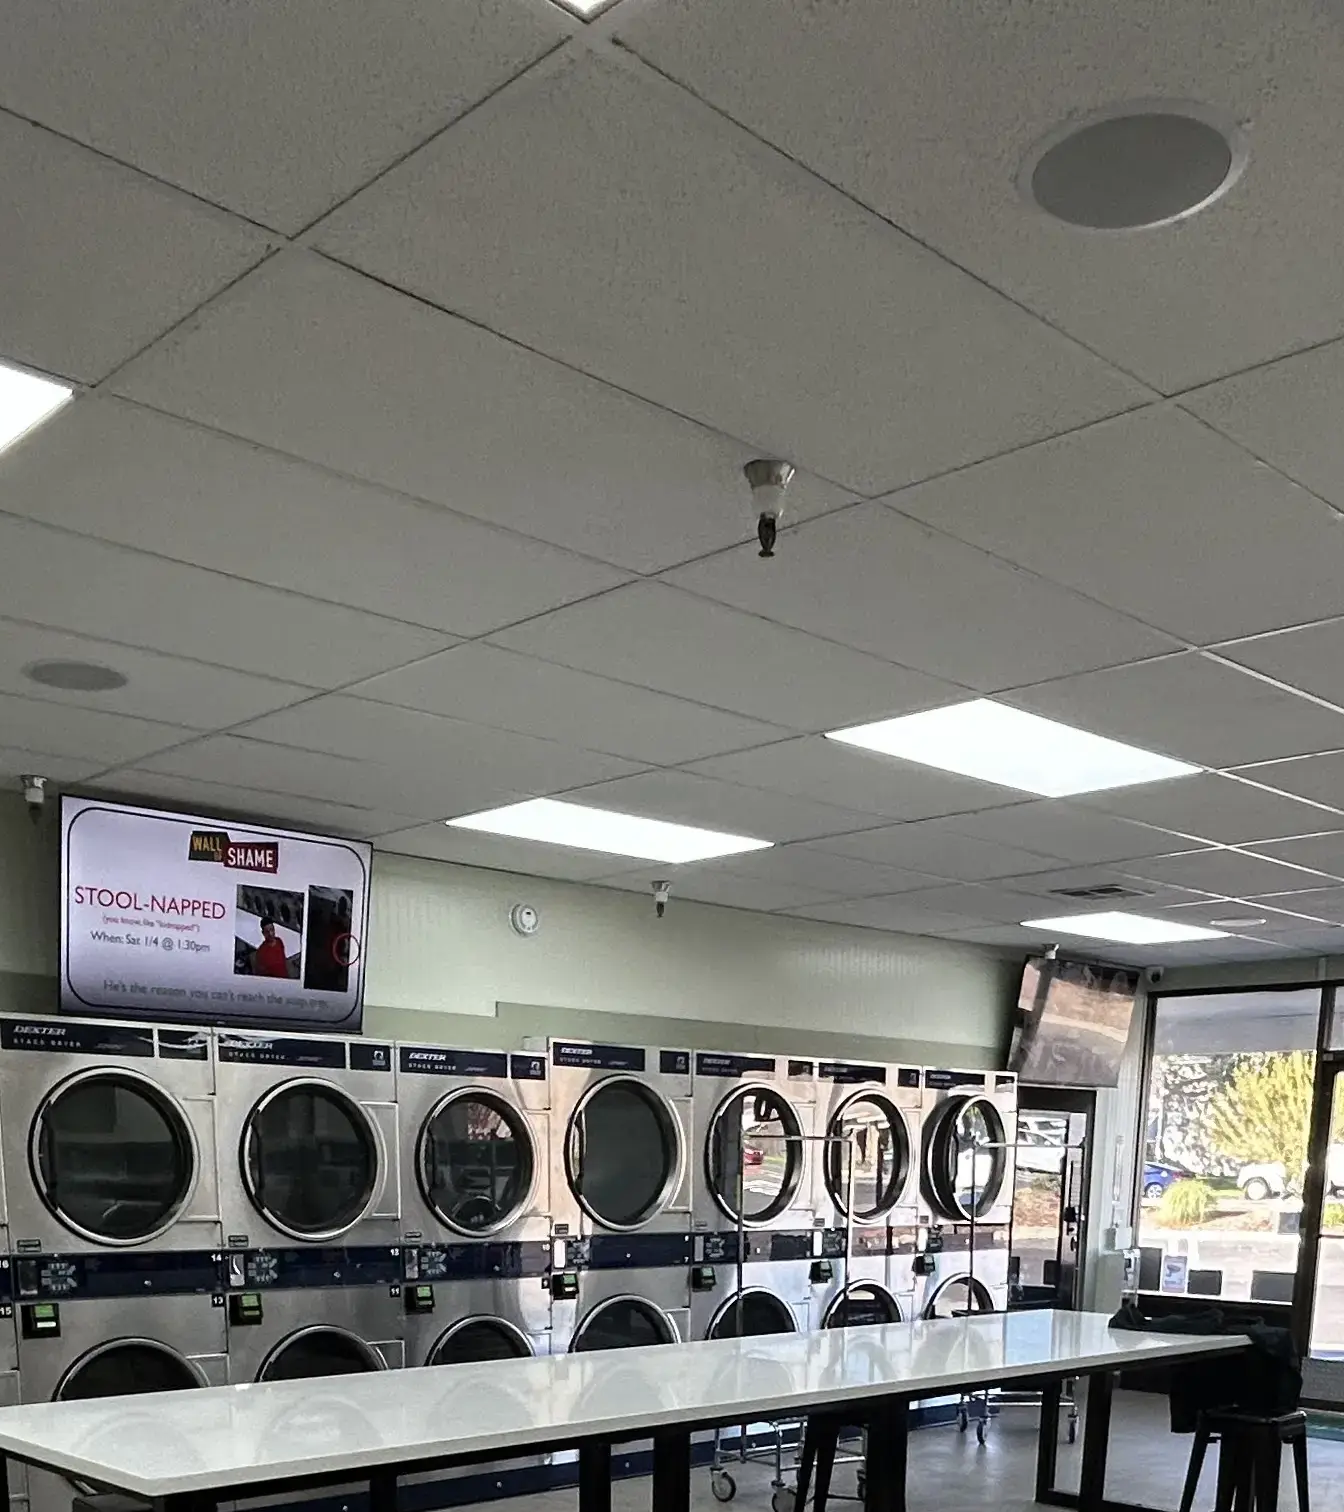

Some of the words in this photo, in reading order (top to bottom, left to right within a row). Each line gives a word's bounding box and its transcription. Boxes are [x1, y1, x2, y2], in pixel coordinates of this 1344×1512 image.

[192, 835, 222, 852] WALL
[228, 847, 274, 868] SHAME
[74, 886, 226, 920] STOOL-NAPPED
[90, 930, 124, 945] When:
[144, 936, 159, 947] 1/4
[162, 937, 174, 951] @
[130, 981, 147, 995] the
[13, 1025, 66, 1036] DEXTER
[409, 1052, 447, 1061] DEXTER
[211, 1254, 222, 1262] 14
[390, 1287, 400, 1296] 11
[213, 1296, 224, 1305] 13
[0, 1306, 12, 1316] 15
